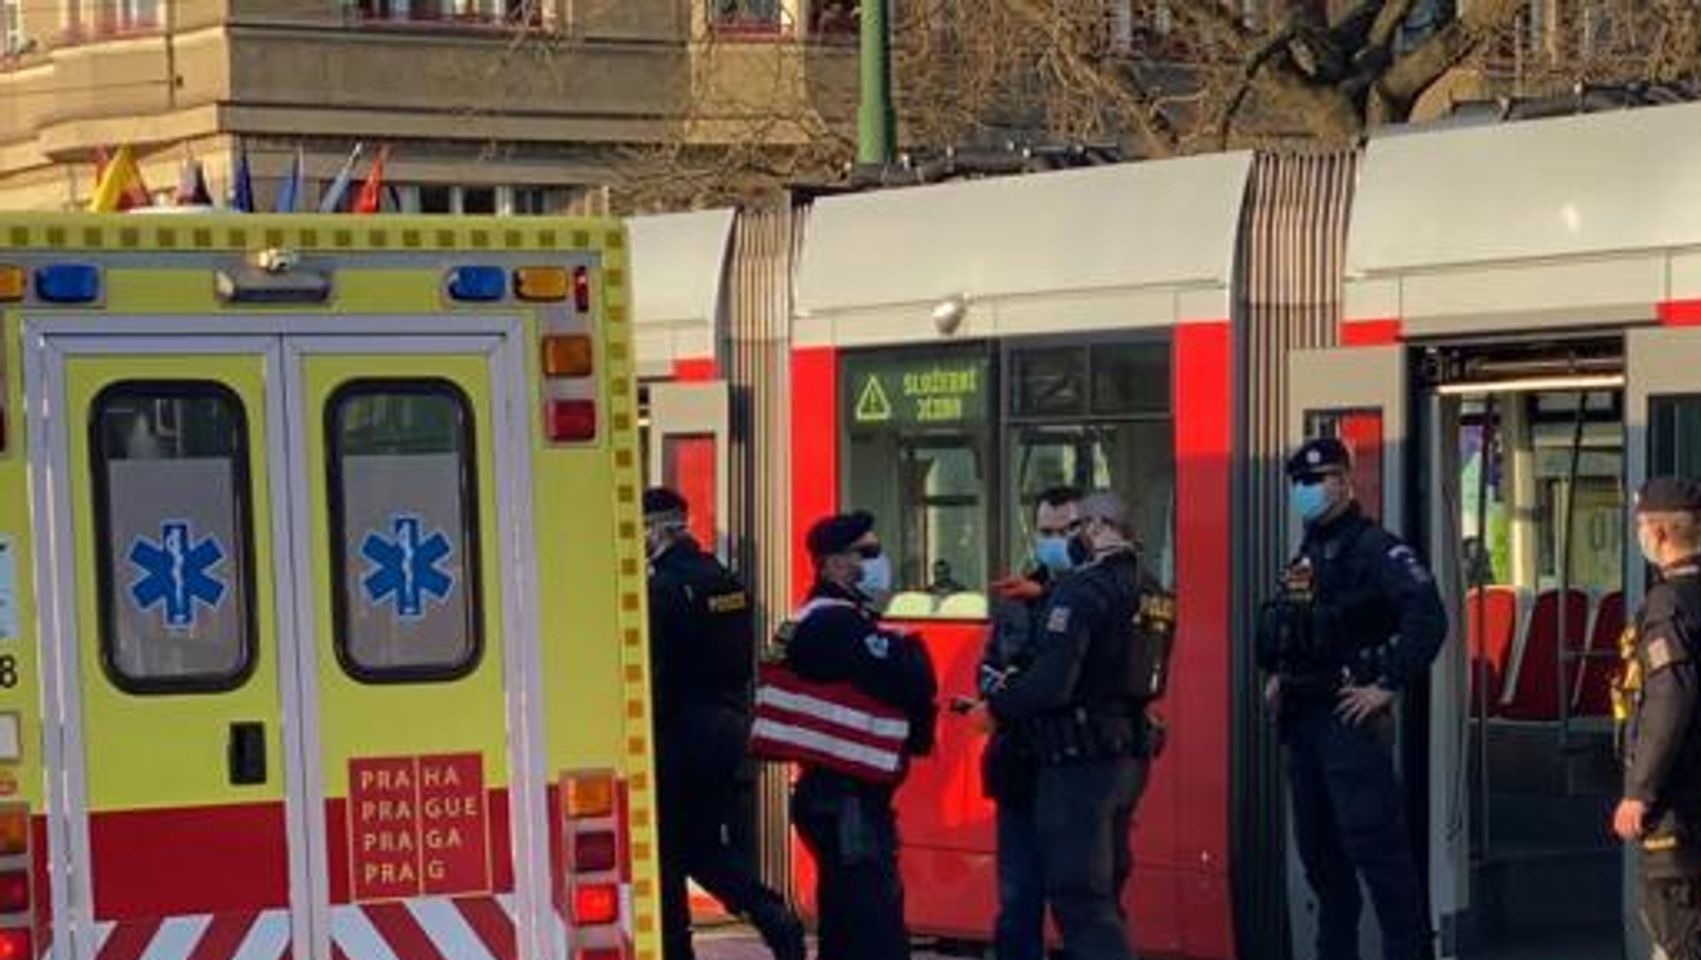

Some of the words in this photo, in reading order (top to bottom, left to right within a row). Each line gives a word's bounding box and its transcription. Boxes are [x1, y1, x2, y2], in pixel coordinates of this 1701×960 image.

[361, 769, 411, 790] PRA
[424, 765, 460, 787] HA
[361, 800, 412, 821] PRA
[425, 796, 478, 818] GUE
[363, 830, 414, 852] PRA
[425, 826, 462, 849] GA
[364, 860, 416, 885] PRA
[427, 858, 446, 879] G
